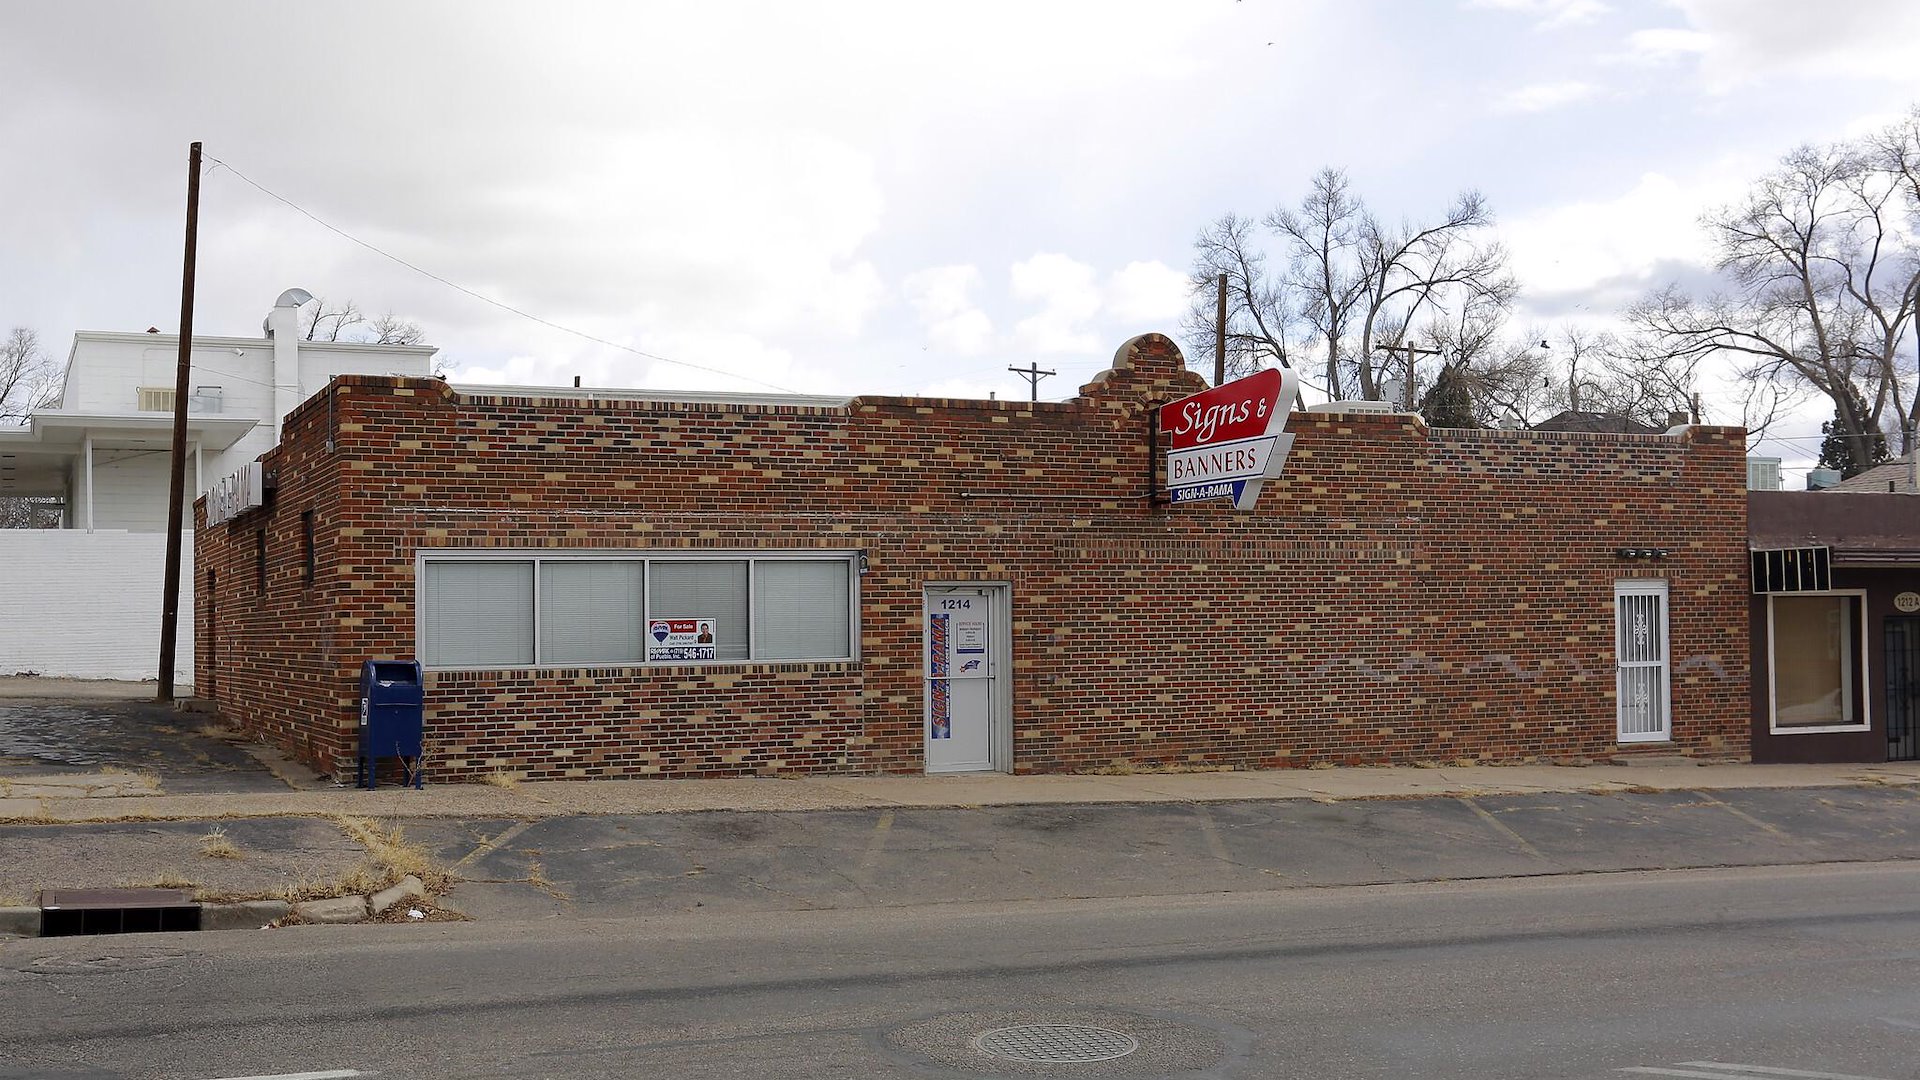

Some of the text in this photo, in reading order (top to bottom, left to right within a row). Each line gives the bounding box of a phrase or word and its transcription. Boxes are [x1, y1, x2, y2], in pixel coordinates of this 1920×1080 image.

[1175, 397, 1267, 443] Signs &
[1174, 448, 1256, 479] BANNERS
[1177, 483, 1234, 501] SIGN-A-RAMA
[941, 599, 971, 610] 1214
[1897, 597, 1913, 606] 1212
